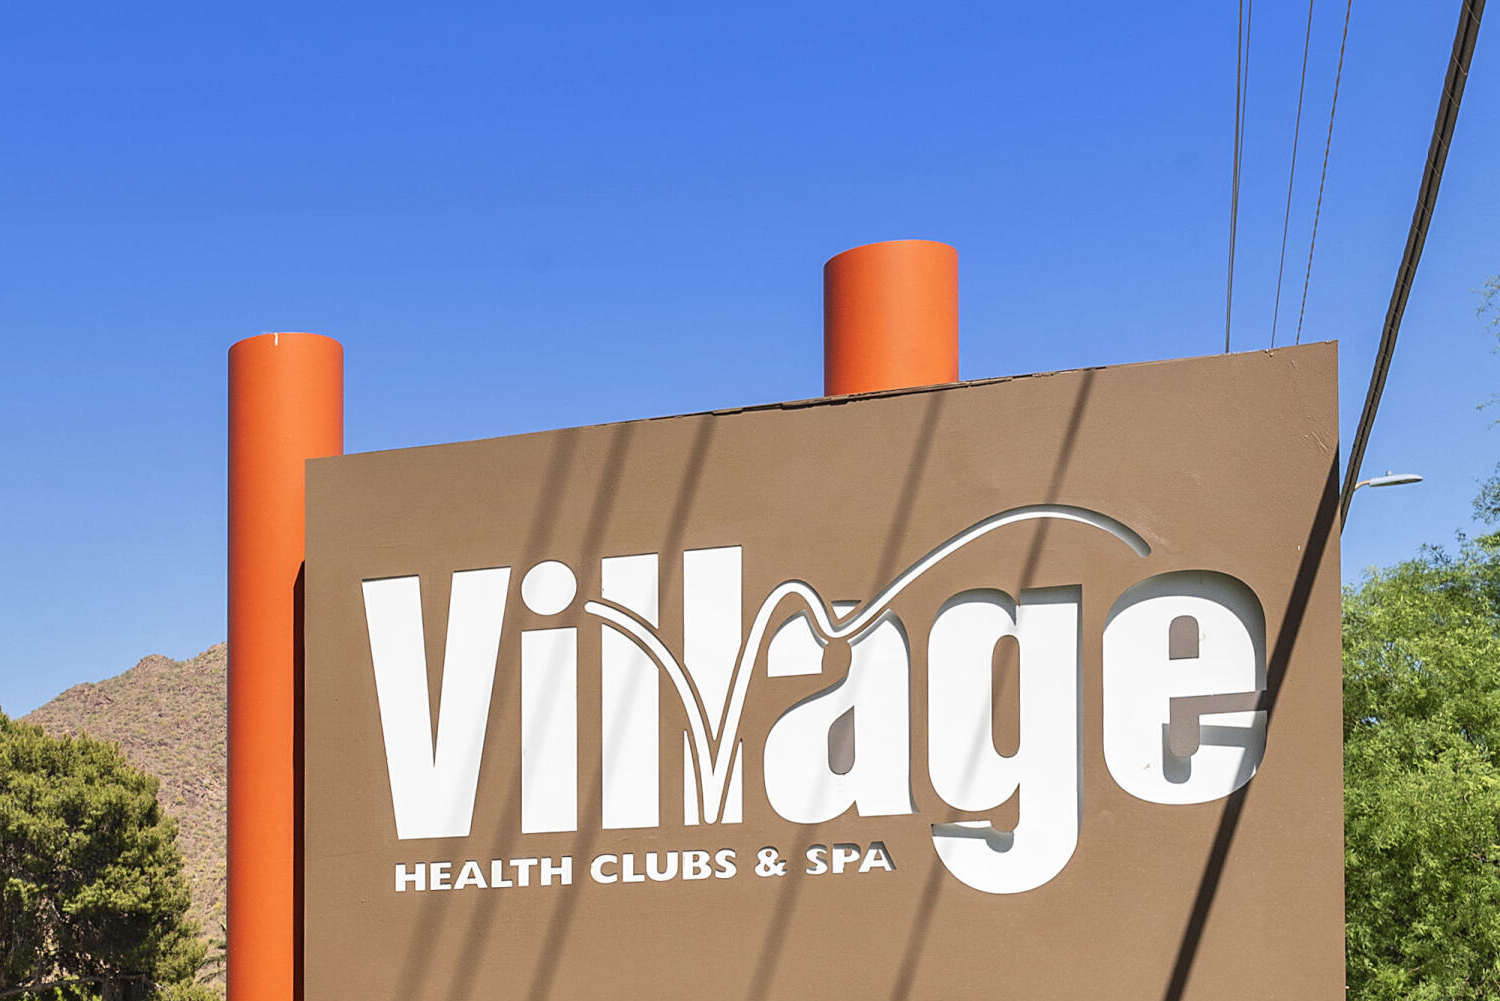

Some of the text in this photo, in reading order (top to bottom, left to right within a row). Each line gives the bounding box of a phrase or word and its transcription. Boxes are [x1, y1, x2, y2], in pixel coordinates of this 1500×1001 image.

[361, 544, 1268, 895] Village
[394, 841, 897, 892] HEALTH CLUBS & SPA
